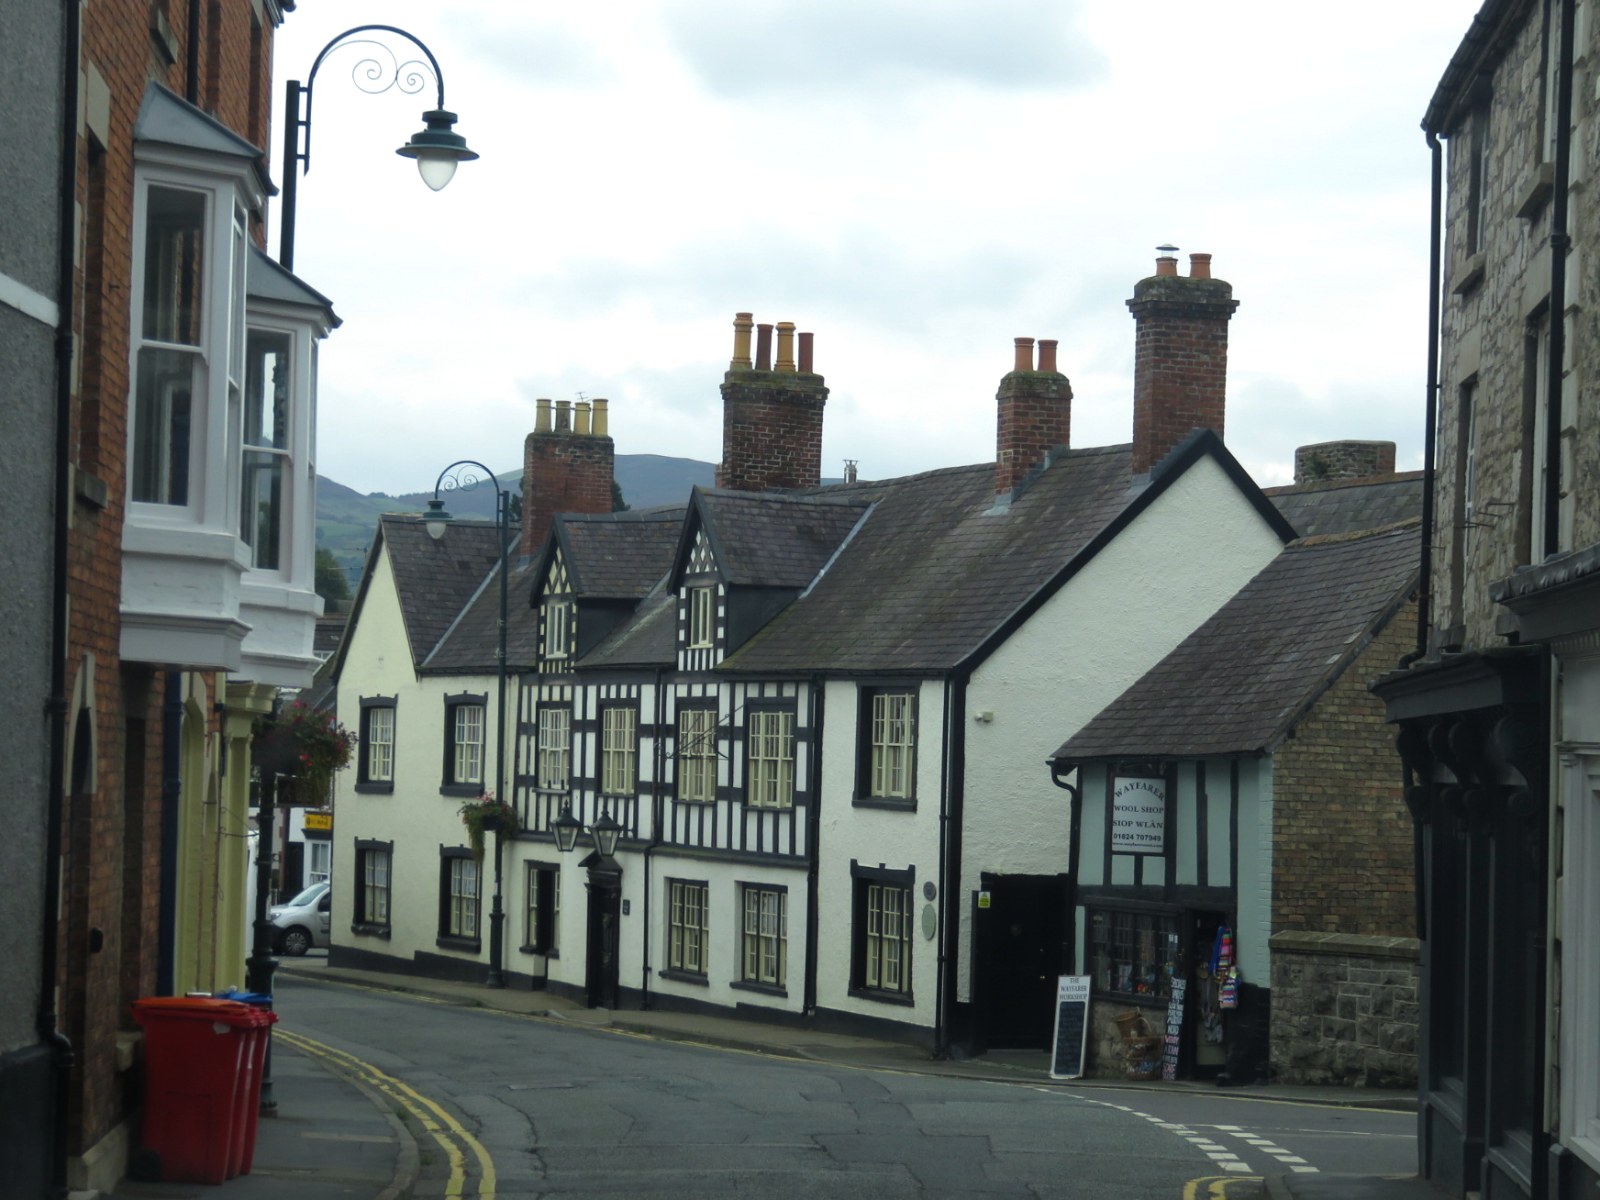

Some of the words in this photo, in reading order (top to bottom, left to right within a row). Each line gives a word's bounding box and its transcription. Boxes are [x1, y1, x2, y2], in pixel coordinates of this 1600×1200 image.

[1114, 781, 1164, 802] WAYFARER
[1114, 805, 1139, 813] WOOL
[1141, 806, 1164, 814] SHOP
[1113, 819, 1134, 827] SIOP
